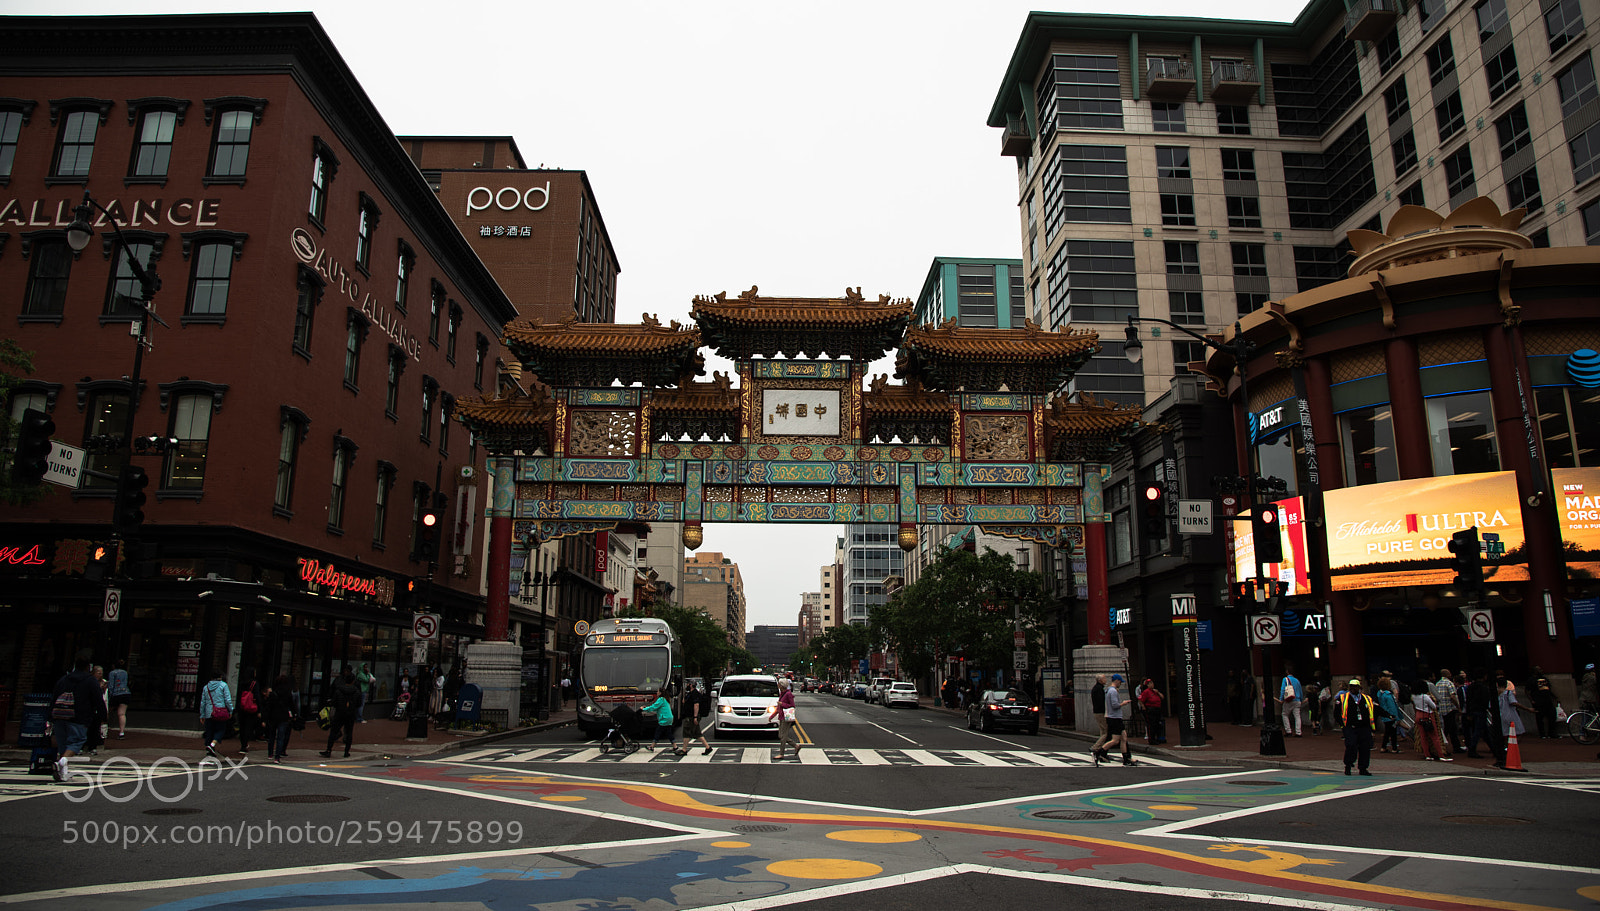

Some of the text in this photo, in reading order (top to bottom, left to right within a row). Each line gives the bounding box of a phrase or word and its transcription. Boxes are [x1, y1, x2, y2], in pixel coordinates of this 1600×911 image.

[466, 181, 551, 216] pod
[0, 198, 221, 227] ALLANCE
[479, 225, 532, 238] 袖珍酒店
[314, 248, 421, 363] AUTO ALLIANCE
[1260, 406, 1284, 431] AT&T
[1297, 398, 1319, 485] 美國娛樂公司
[59, 448, 73, 460] NO
[49, 461, 78, 478] TURNS
[1189, 504, 1201, 512] NO
[1567, 510, 1600, 521] ORG
[1182, 516, 1209, 526] TURNS
[1288, 513, 1298, 521] 85
[1335, 510, 1509, 540] Michelob ULTRA
[1367, 537, 1453, 555] PURE GO
[597, 549, 606, 570] pod
[298, 557, 376, 596] Walgreens
[1171, 598, 1188, 615] M
[1116, 608, 1132, 625] AT&T
[1303, 614, 1327, 630] AT
[595, 635, 605, 644] X2
[1183, 627, 1191, 653] Gallery
[1015, 661, 1026, 669] 25
